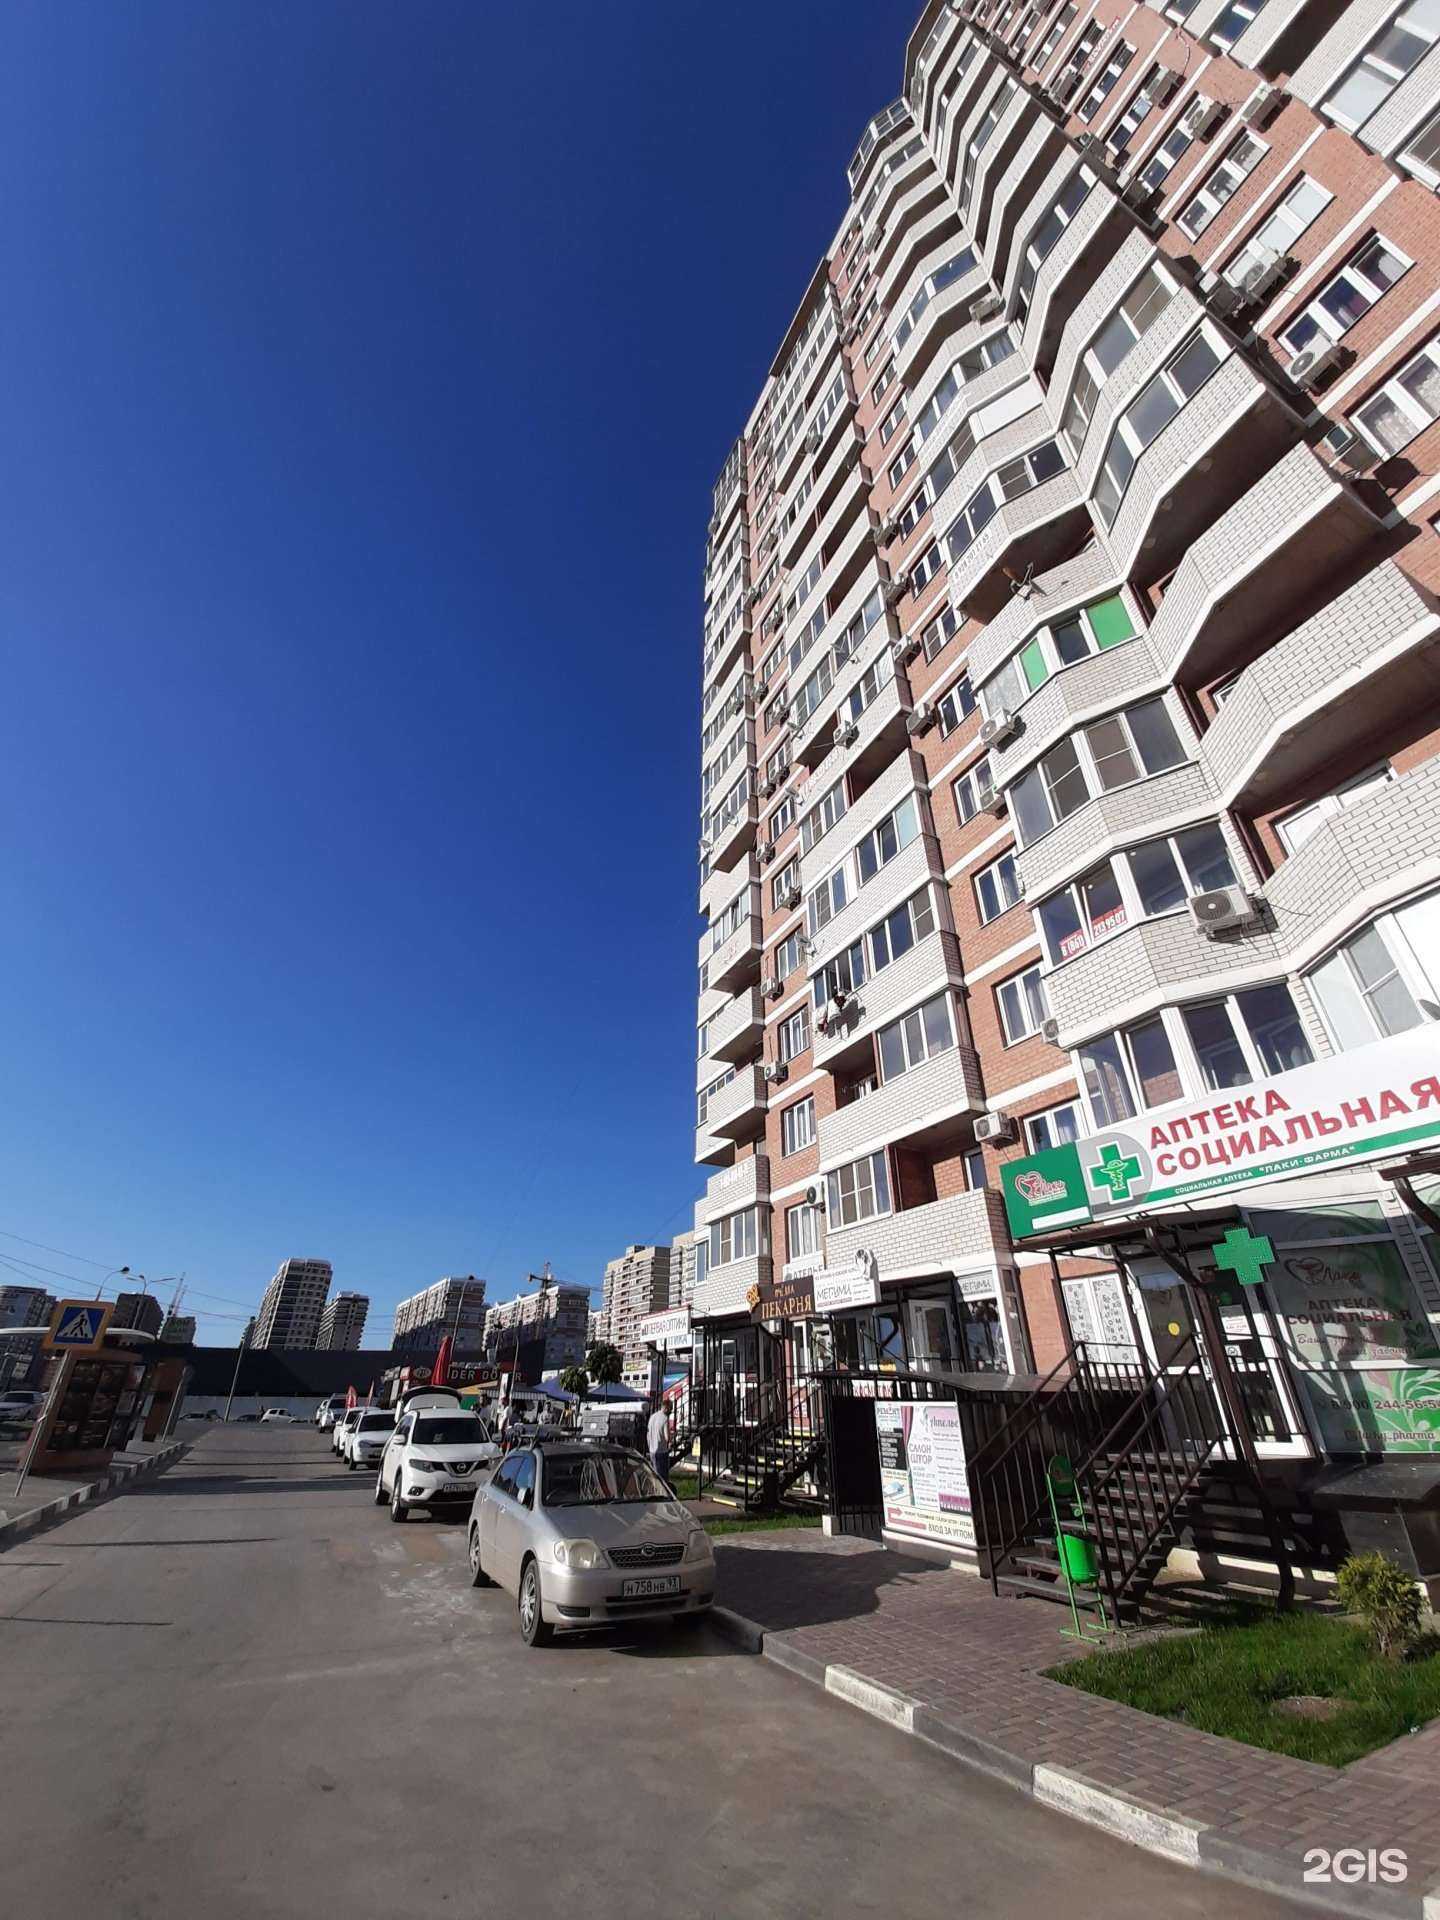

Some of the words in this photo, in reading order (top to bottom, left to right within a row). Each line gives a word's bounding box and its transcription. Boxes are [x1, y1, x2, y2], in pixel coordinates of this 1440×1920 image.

[1150, 1089, 1291, 1148] АПТЕКА
[1156, 1076, 1440, 1175] СОЦИАЛЬНАЯ
[1175, 1178, 1222, 1194] СОЦИАЛЬНАЯ
[1224, 1171, 1253, 1185] АПТЕКА
[761, 1295, 811, 1319] ПЕКАРНЯ
[1307, 1296, 1378, 1311] АПТЕКА
[1288, 1310, 1413, 1325] СОЦИАЛЬНАЯ
[909, 1443, 931, 1453] САЛОН
[910, 1452, 933, 1464] ШТОР
[928, 1523, 944, 1534] ВХОД
